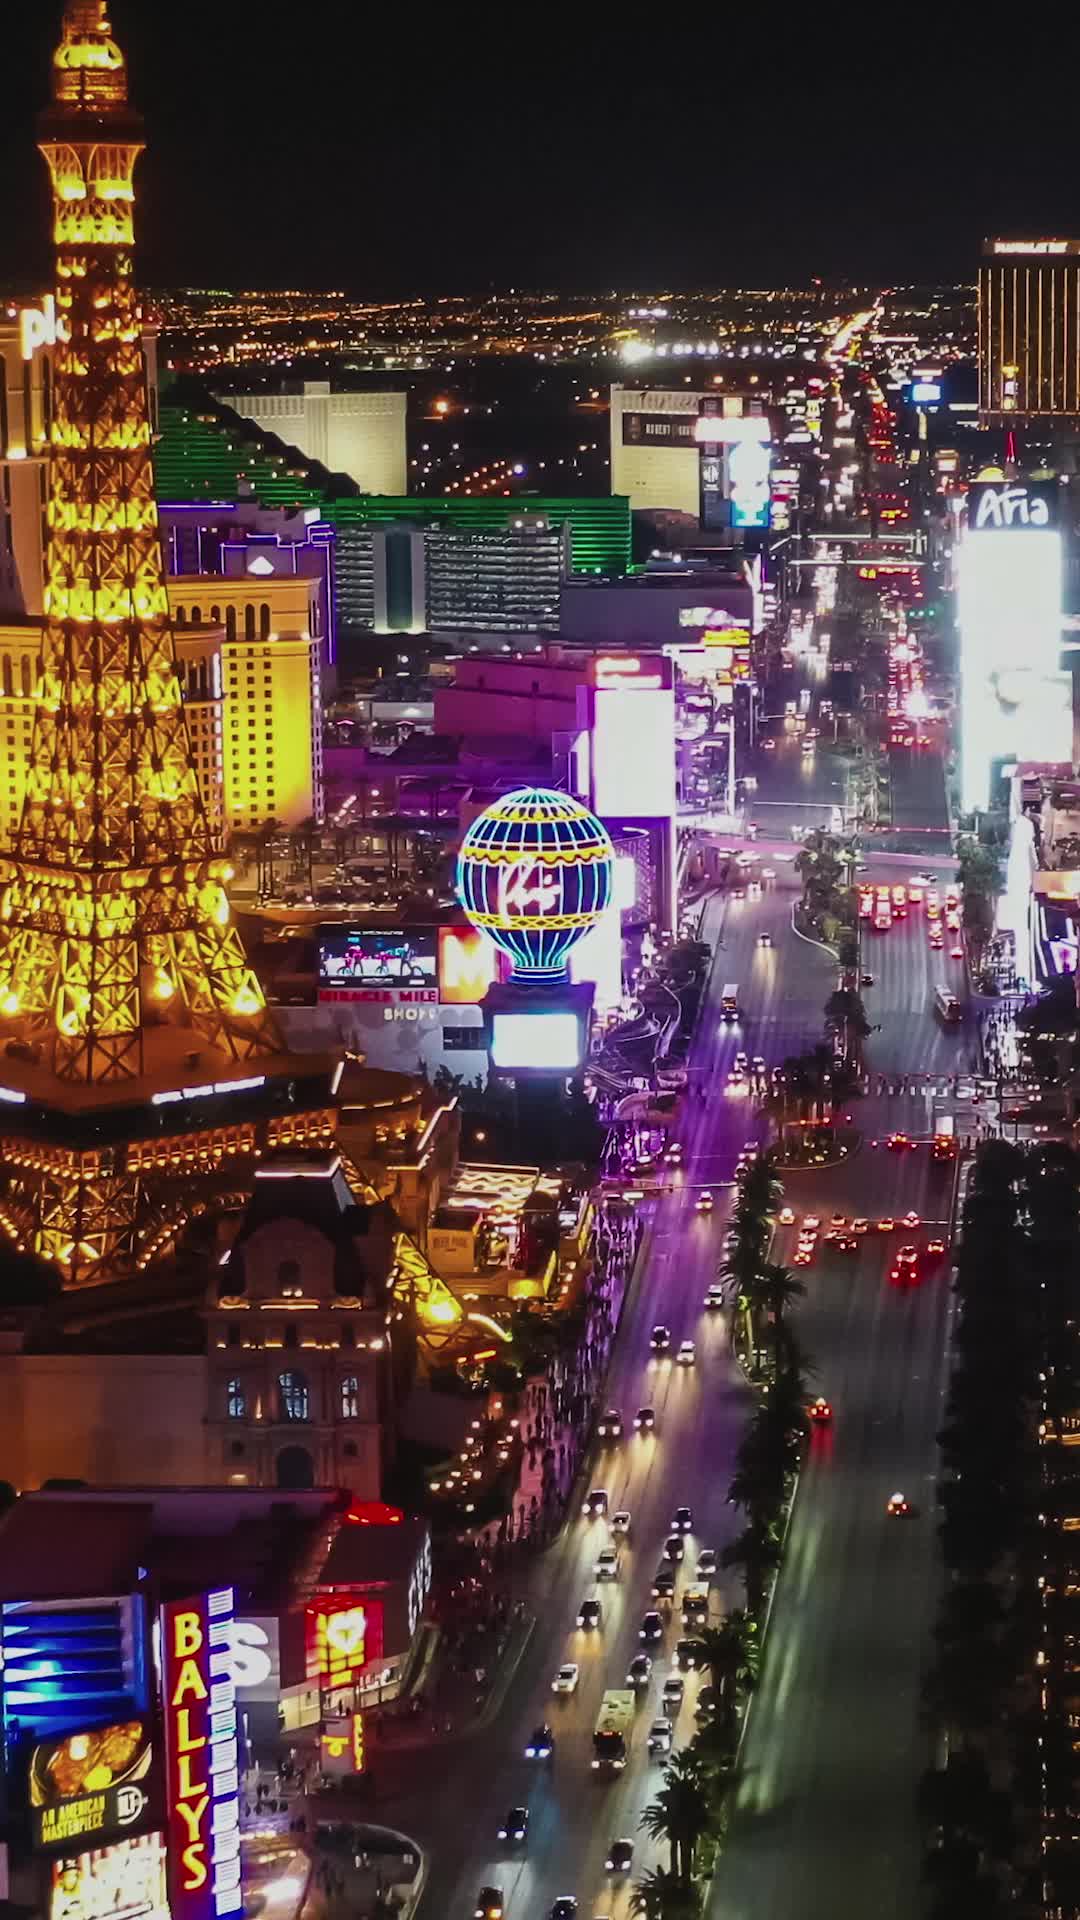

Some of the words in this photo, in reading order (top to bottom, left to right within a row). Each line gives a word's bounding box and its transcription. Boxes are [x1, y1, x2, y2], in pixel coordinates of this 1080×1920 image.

[976, 487, 1049, 528] Aria
[42, 1808, 105, 1843] MASTERPIECE
[58, 1794, 106, 1823] AMERICAN
